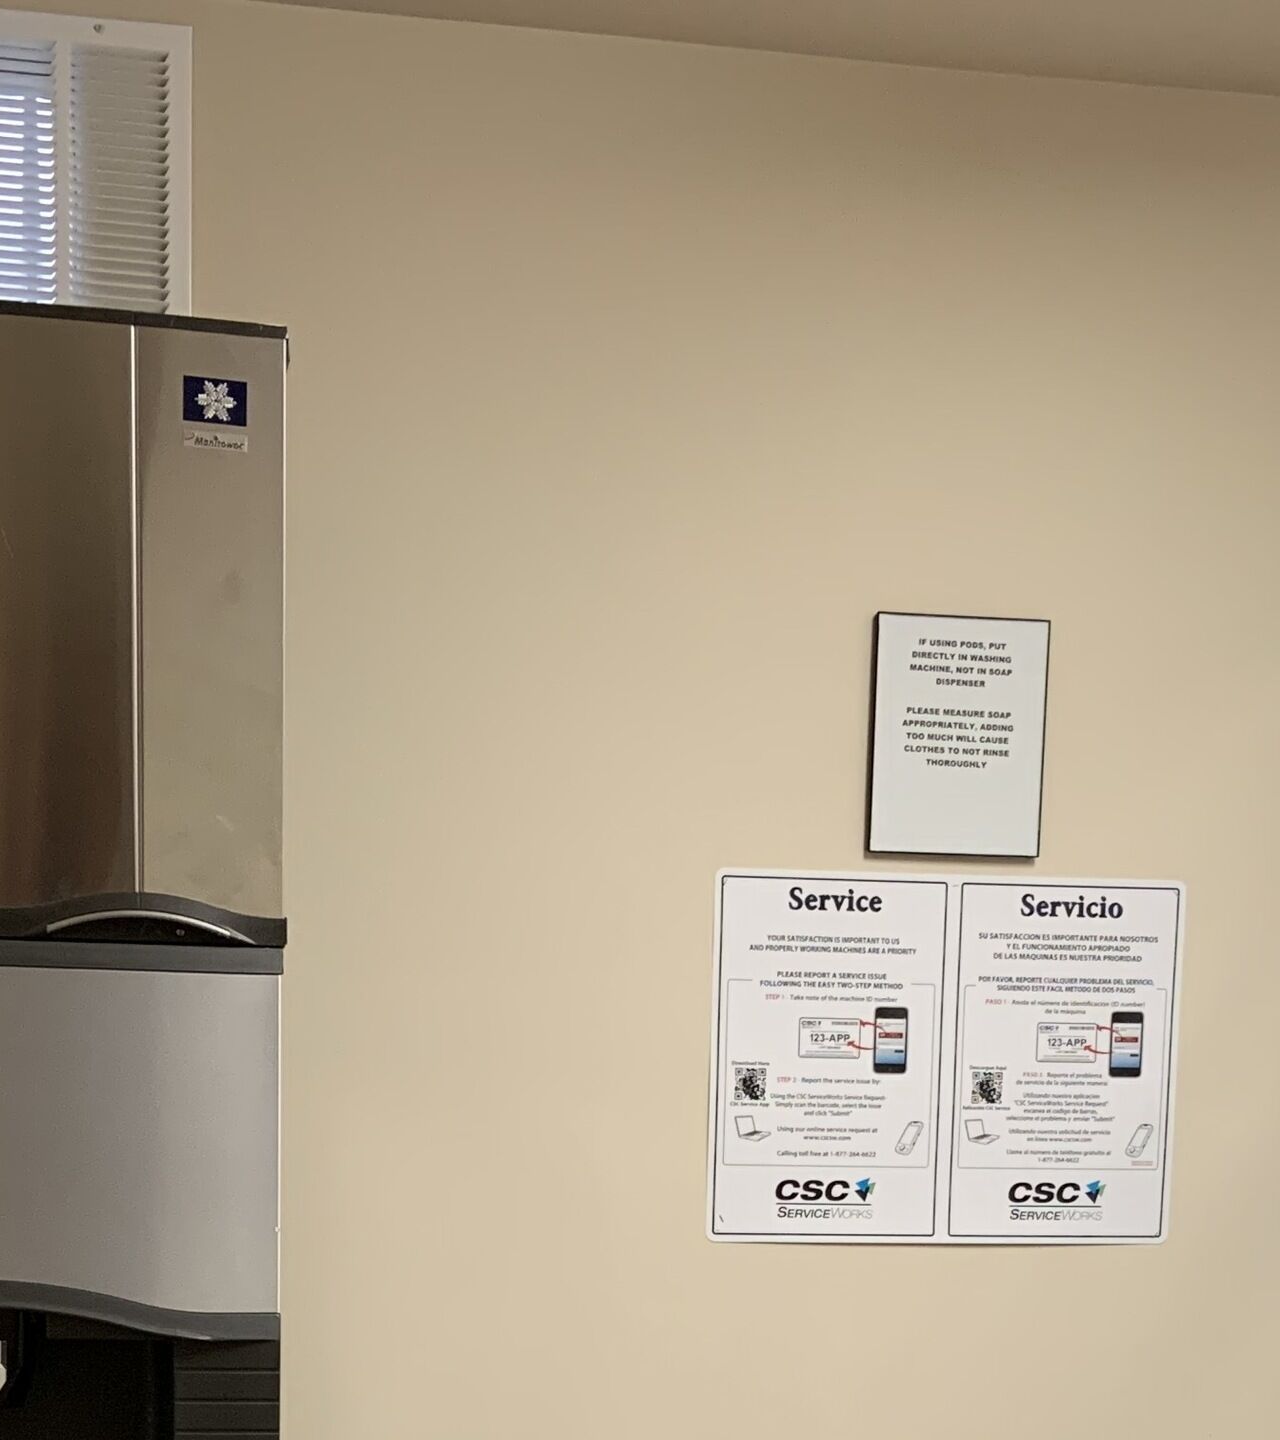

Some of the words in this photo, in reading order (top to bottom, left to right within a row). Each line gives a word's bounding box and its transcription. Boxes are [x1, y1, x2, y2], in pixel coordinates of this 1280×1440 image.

[930, 639, 957, 647] USING
[960, 641, 986, 649] PODS,
[912, 651, 955, 660] DIRECTLY
[970, 655, 1012, 663] WASHING
[910, 664, 953, 673] MACHINE,
[989, 668, 1012, 676] SOAP
[936, 678, 985, 687] DISPENSER
[907, 707, 940, 715] PLEASE
[943, 709, 984, 717] MEASURE
[987, 711, 1011, 719] SOAP
[902, 720, 978, 730] APPROPRIATELY,
[980, 724, 1014, 732] ADDING
[956, 735, 976, 743] WILL
[979, 736, 1008, 744] CAUSE
[904, 746, 945, 754] CLOTHES
[983, 749, 1009, 757] RINSE
[926, 759, 987, 768] THOROUGHLY
[788, 887, 883, 912] Service
[1020, 894, 1124, 918] Servicio
[990, 933, 1040, 941] SATISFACCION
[1052, 934, 1097, 942] IMPORTANTE
[810, 1034, 850, 1042] 123-APP
[1047, 1038, 1087, 1047] 123-APP
[775, 1179, 850, 1201] CSC
[1008, 1182, 1080, 1203] CSC
